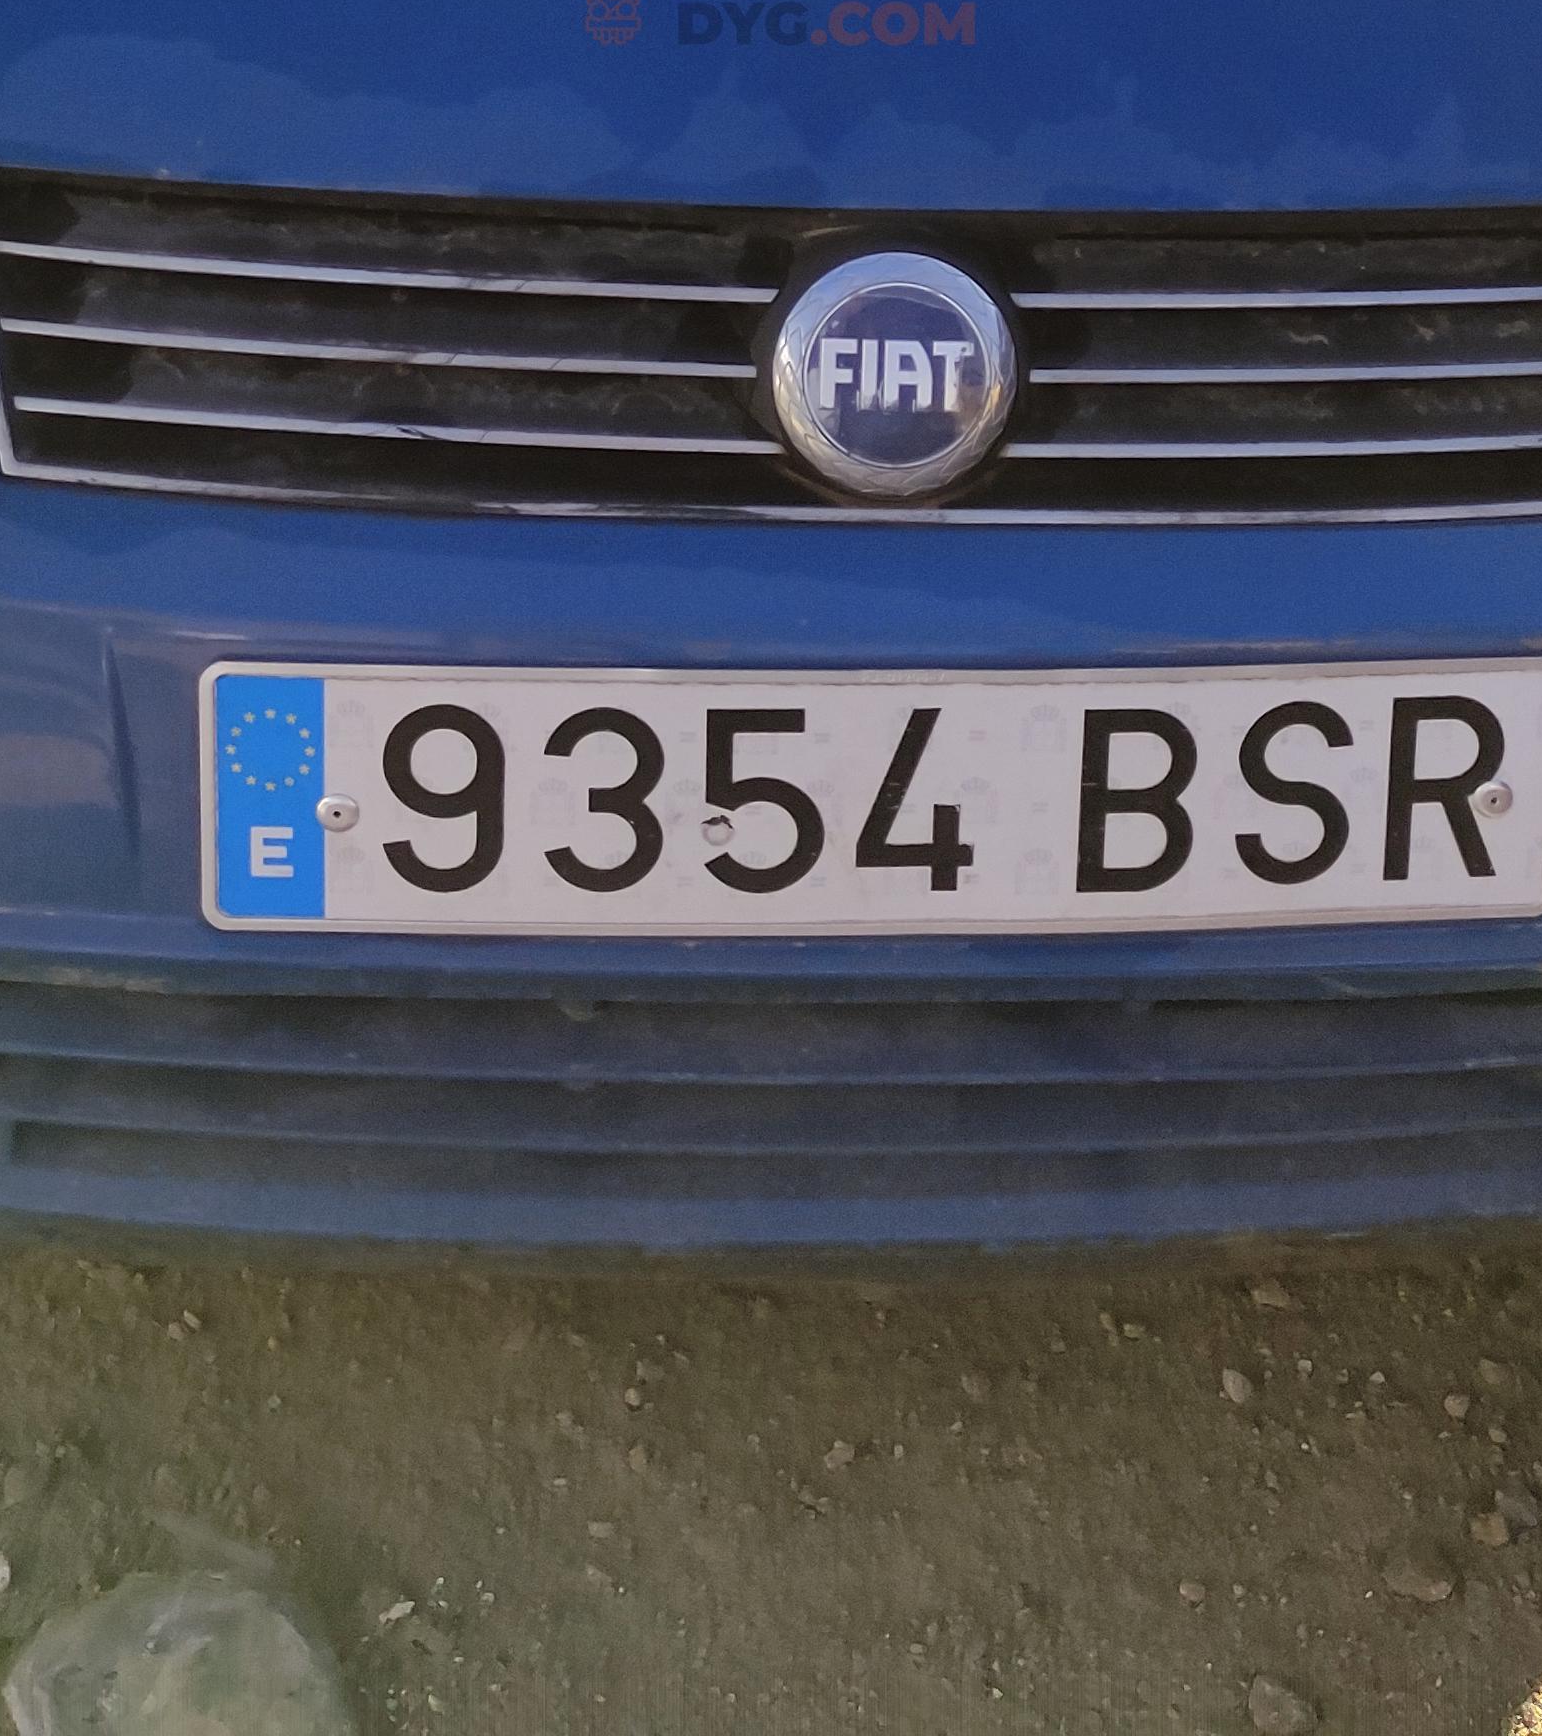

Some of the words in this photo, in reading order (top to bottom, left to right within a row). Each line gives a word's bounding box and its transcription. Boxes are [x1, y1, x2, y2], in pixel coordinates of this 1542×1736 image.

[819, 337, 975, 413] FIAT
[381, 702, 975, 894] 9354
[1075, 695, 1506, 893] BSR
[250, 825, 294, 878] E
